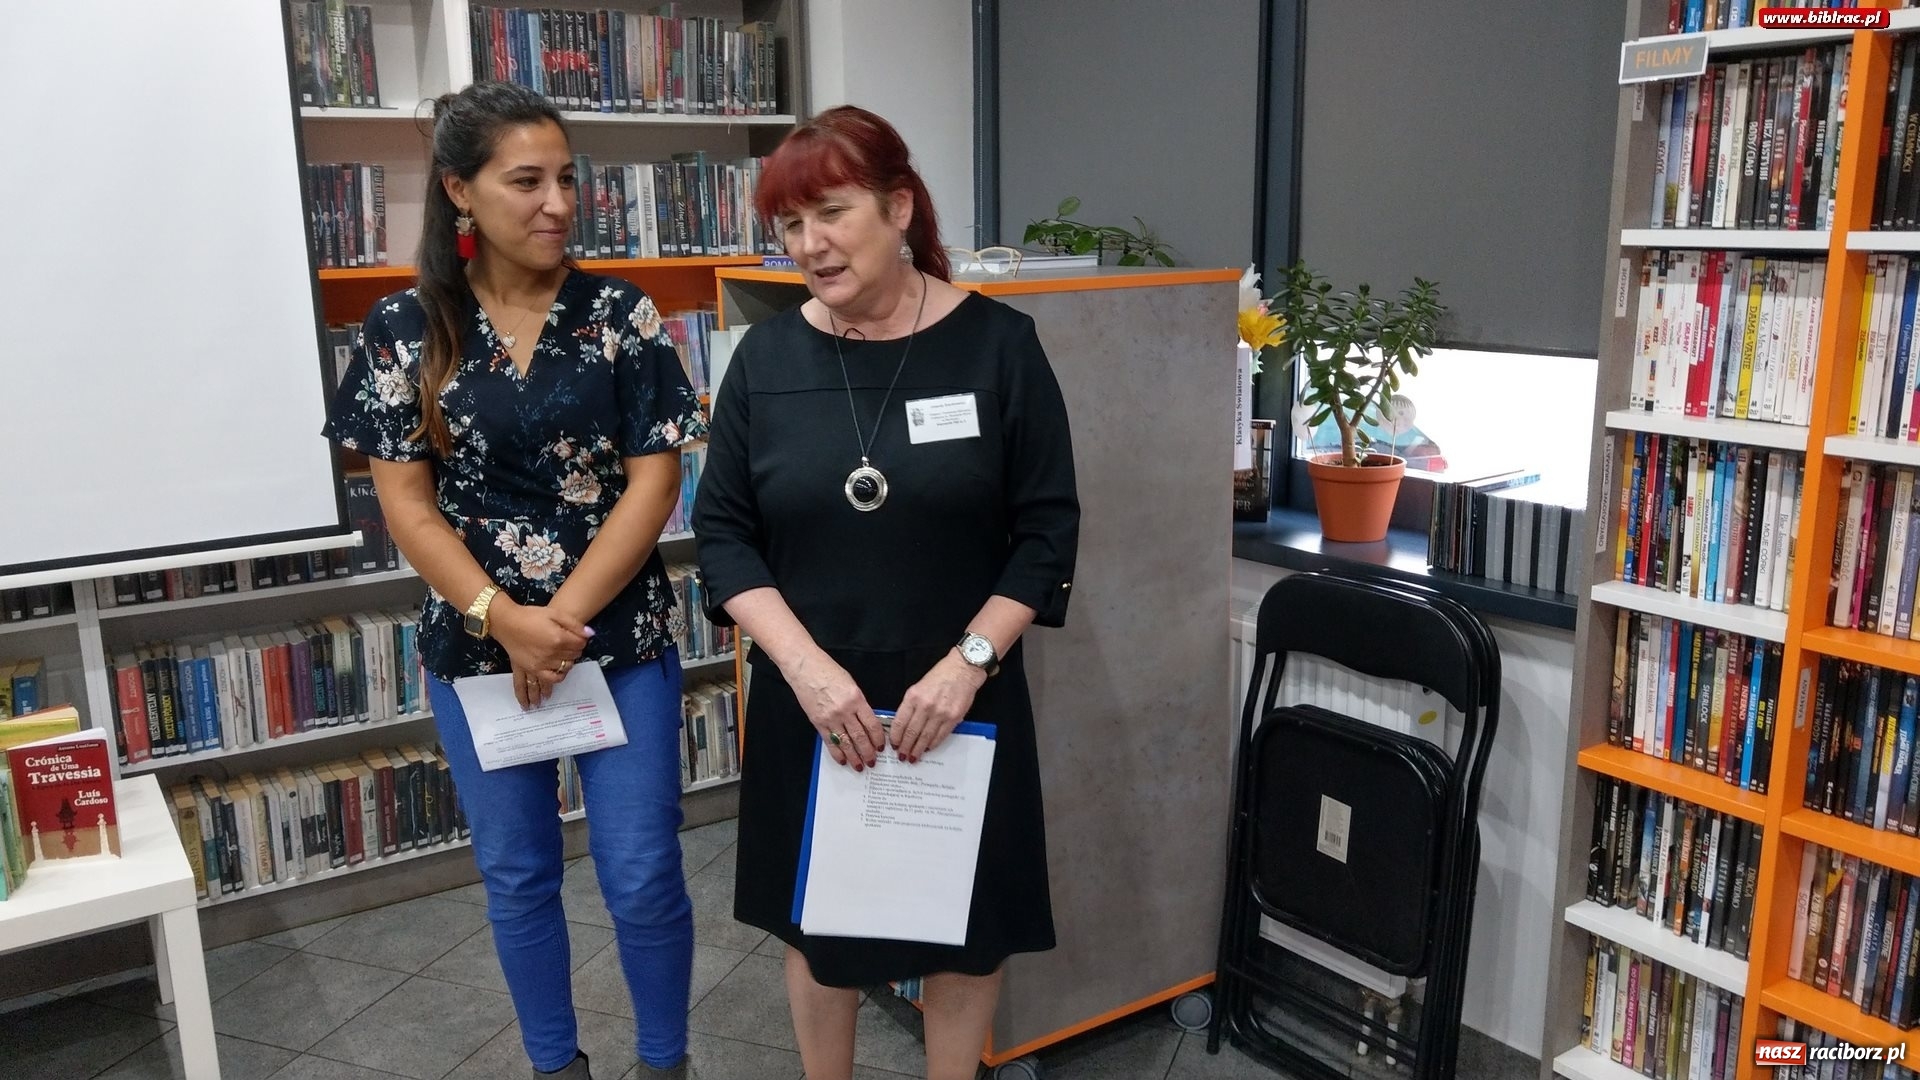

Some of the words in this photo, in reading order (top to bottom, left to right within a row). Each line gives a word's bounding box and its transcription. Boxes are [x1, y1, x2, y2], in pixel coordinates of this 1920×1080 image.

[333, 17, 343, 78] ROSENFELDT
[1635, 46, 1693, 69] FILMY
[1683, 111, 1694, 133] Moje
[1814, 120, 1826, 159] NIEWINNE
[1902, 123, 1916, 173] CIEMNOŚCI
[1811, 296, 1817, 305] ZA
[1682, 322, 1692, 354] DRUHNY
[1236, 408, 1244, 445] Klasyka
[1598, 492, 1609, 547] OBYCZAJOWE
[1604, 443, 1612, 484] DRAMATY
[1762, 523, 1771, 547] MOJE
[1841, 517, 1856, 581] PRZESZŁOŚĆ
[1760, 549, 1770, 574] CÓRKI
[147, 692, 161, 741] NIEŚMIERTELNY
[1700, 684, 1710, 724] SHERLOCK
[1739, 685, 1748, 720] INFERNO
[1813, 718, 1822, 744] WODY
[25, 754, 72, 767] Crónica
[27, 766, 101, 785] Travessia
[50, 764, 59, 772] de
[74, 797, 108, 806] Cardoso
[78, 789, 100, 799] Luís
[1691, 838, 1702, 892] STALINGRAD
[1717, 858, 1728, 903] INTERNAT
[1733, 878, 1742, 908] WIDMO
[1746, 867, 1756, 898] DROGA
[1871, 922, 1880, 951] CHATA
[1881, 920, 1893, 958] NIEULOTNE
